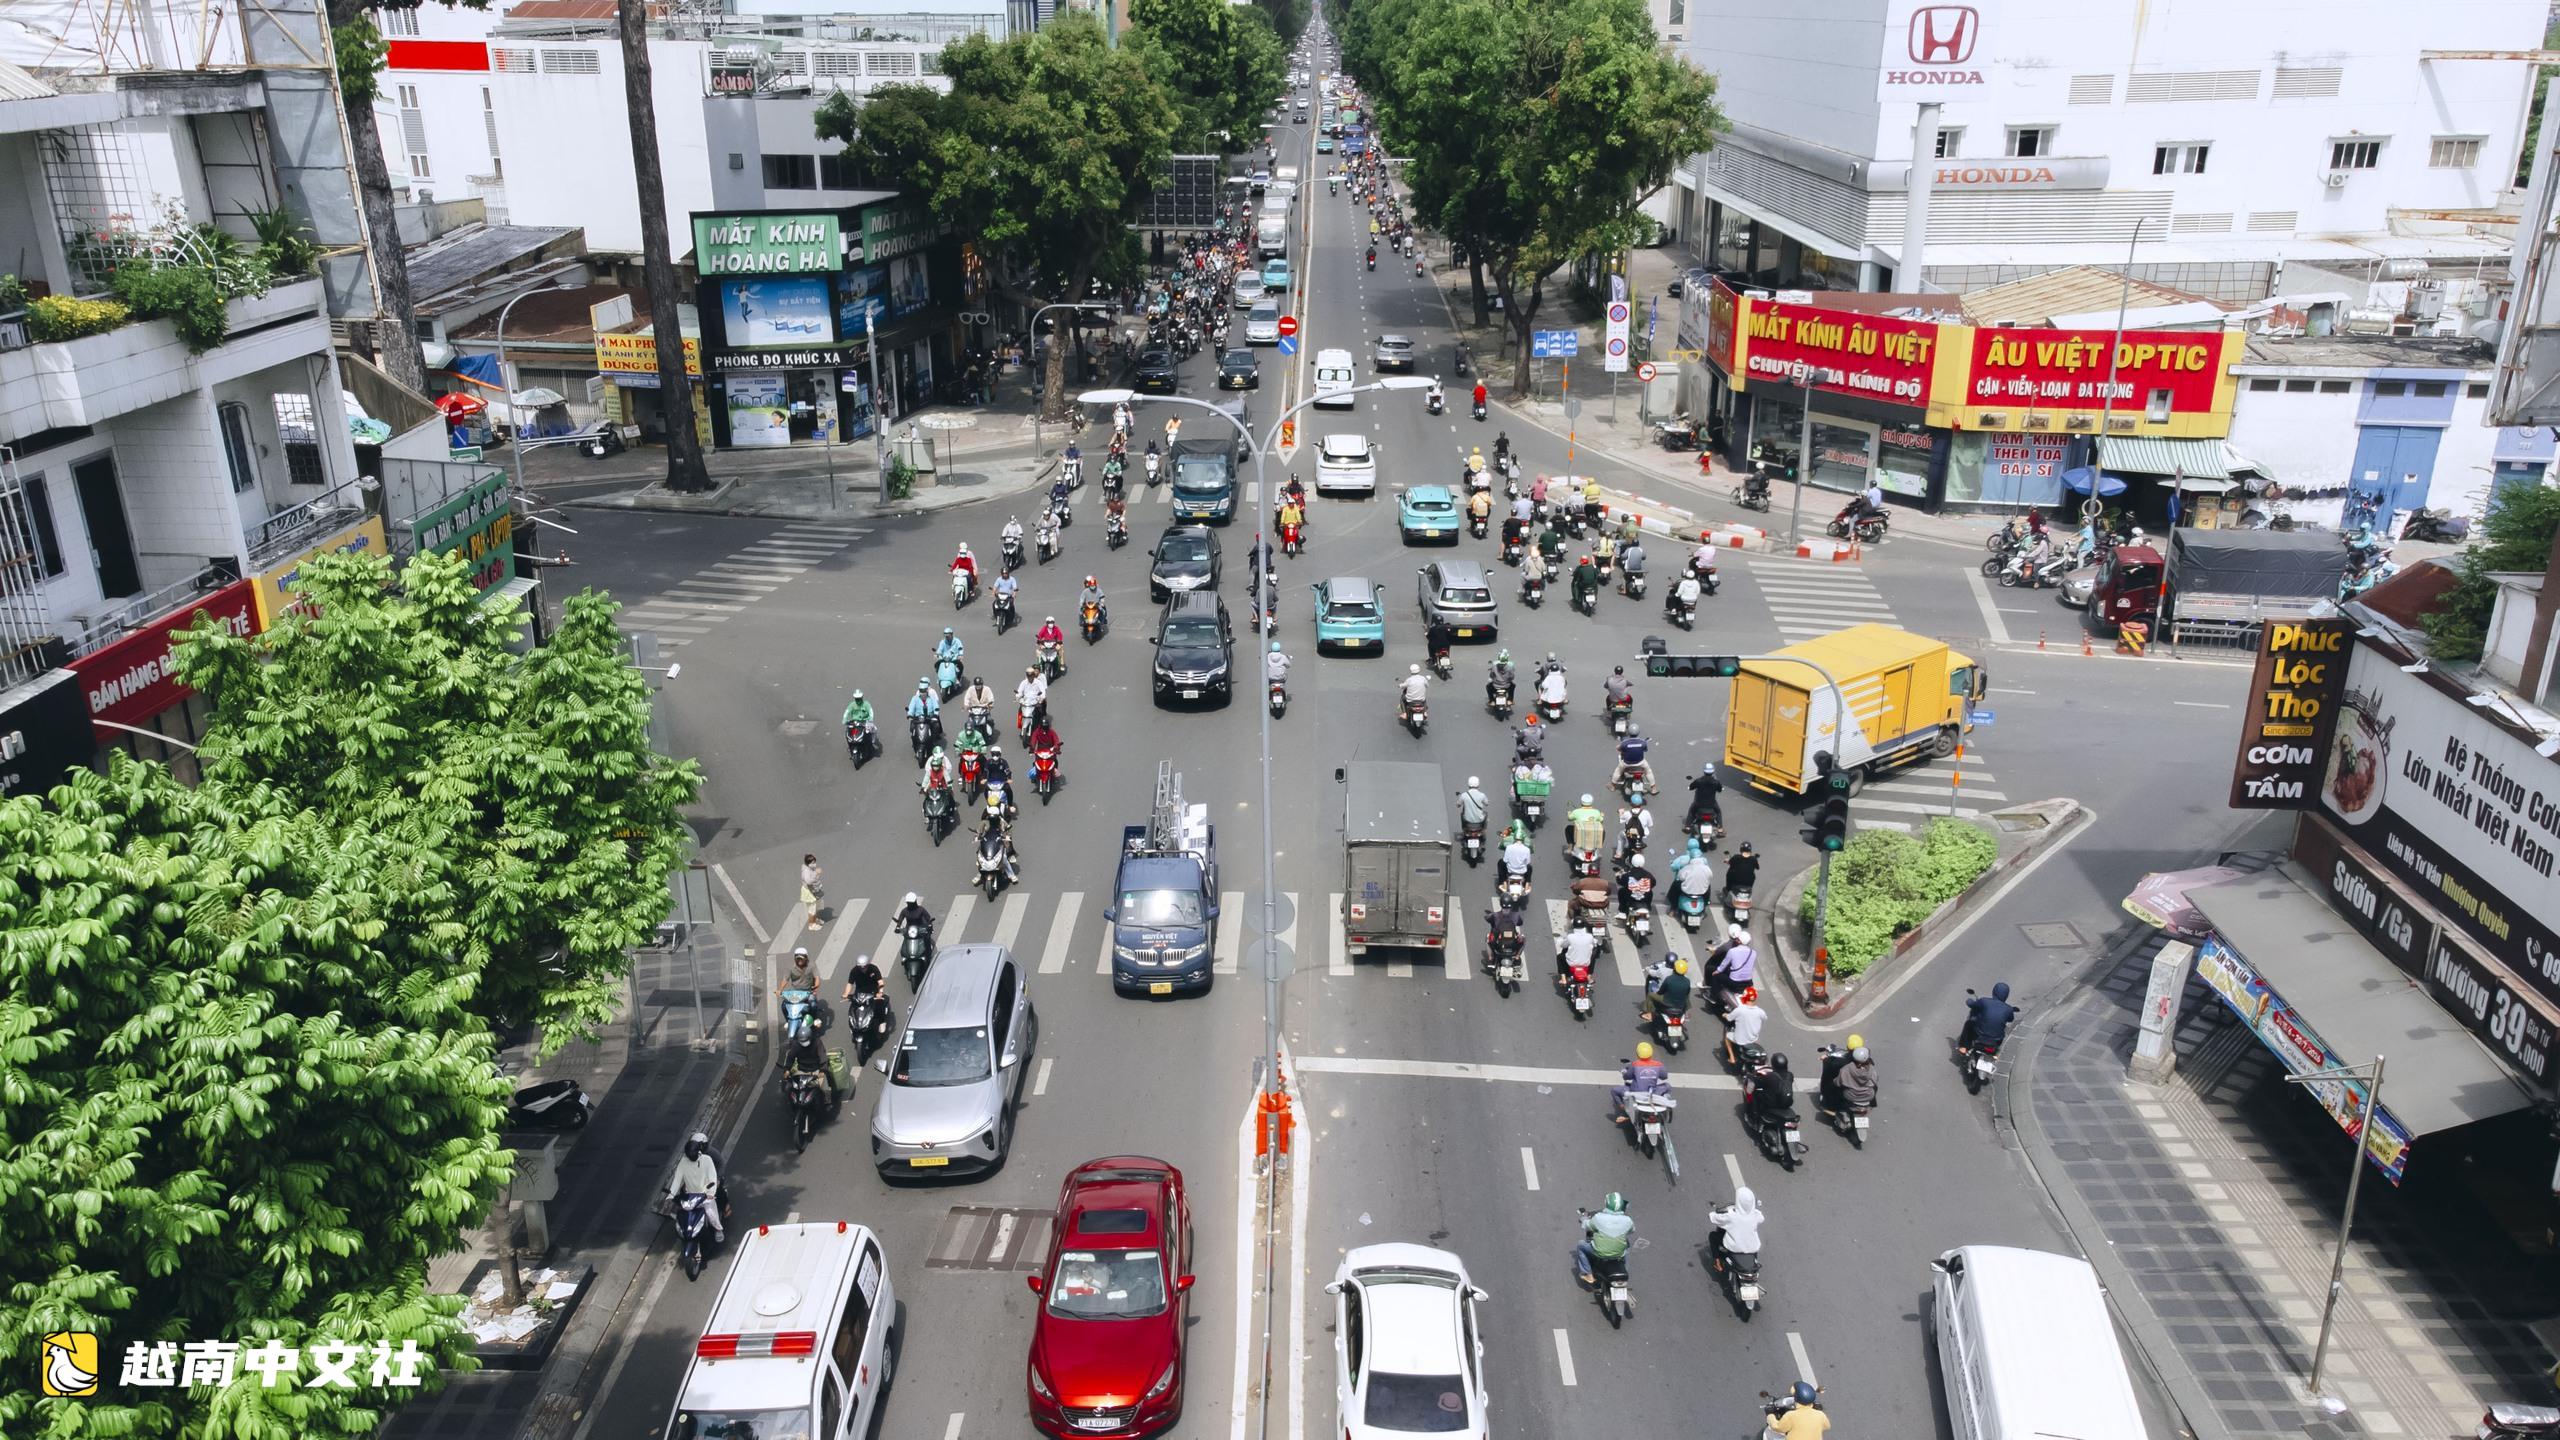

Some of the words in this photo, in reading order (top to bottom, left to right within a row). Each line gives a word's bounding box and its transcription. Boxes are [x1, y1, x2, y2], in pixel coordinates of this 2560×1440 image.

[1886, 71, 1985, 84] HONDA
[1935, 167, 2056, 184] HONDA
[709, 217, 756, 246] MẮT
[769, 218, 826, 244] KÍNH
[711, 249, 790, 274] HOÀNG
[800, 246, 830, 270] HÀ
[609, 338, 632, 348] MAI
[1750, 305, 1791, 341] MẮT
[1796, 316, 1844, 351] KÍNH
[1848, 322, 1878, 356] ÂU
[1885, 330, 1932, 367] VIỆT
[715, 353, 759, 367] PHÒNG
[763, 354, 781, 366] ĐO
[785, 351, 820, 365] KHÚC
[824, 352, 841, 366] XẠ
[1985, 336, 2028, 367] ÂU
[2036, 336, 2104, 374] VIỆT
[2115, 343, 2209, 372] OPTIC
[1849, 369, 1890, 393] KÍNH
[1895, 378, 1921, 401] ĐỘ
[1976, 377, 1999, 396] CẬN
[2007, 375, 2032, 396] VIỄN
[2041, 380, 2070, 399] LOẠN
[2078, 382, 2093, 398] ĐA
[1994, 447, 2030, 460] THEO
[2270, 624, 2343, 652] Phúc
[88, 679, 121, 714] BÁN
[120, 660, 160, 697] HÀNG
[2273, 658, 2326, 688] Lộc
[2266, 692, 2320, 723] Thọ
[2289, 727, 2311, 735] 2005
[2247, 744, 2314, 764] CƠM
[2245, 773, 2304, 799] TẤM
[2444, 735, 2468, 777] Hệ
[2471, 751, 2526, 814] Thống
[2403, 750, 2431, 791] Lớn
[2432, 770, 2473, 820] Nhất
[2474, 798, 2510, 847] Việt
[2510, 824, 2555, 878] Nam
[2333, 860, 2378, 920] Sườn
[2387, 832, 2404, 858] Liên
[2403, 844, 2415, 869] Hệ
[2416, 853, 2428, 875] Tư
[2441, 872, 2479, 917] Nhượng
[2478, 901, 2510, 942] Quyền
[2435, 947, 2490, 1021] Nướng
